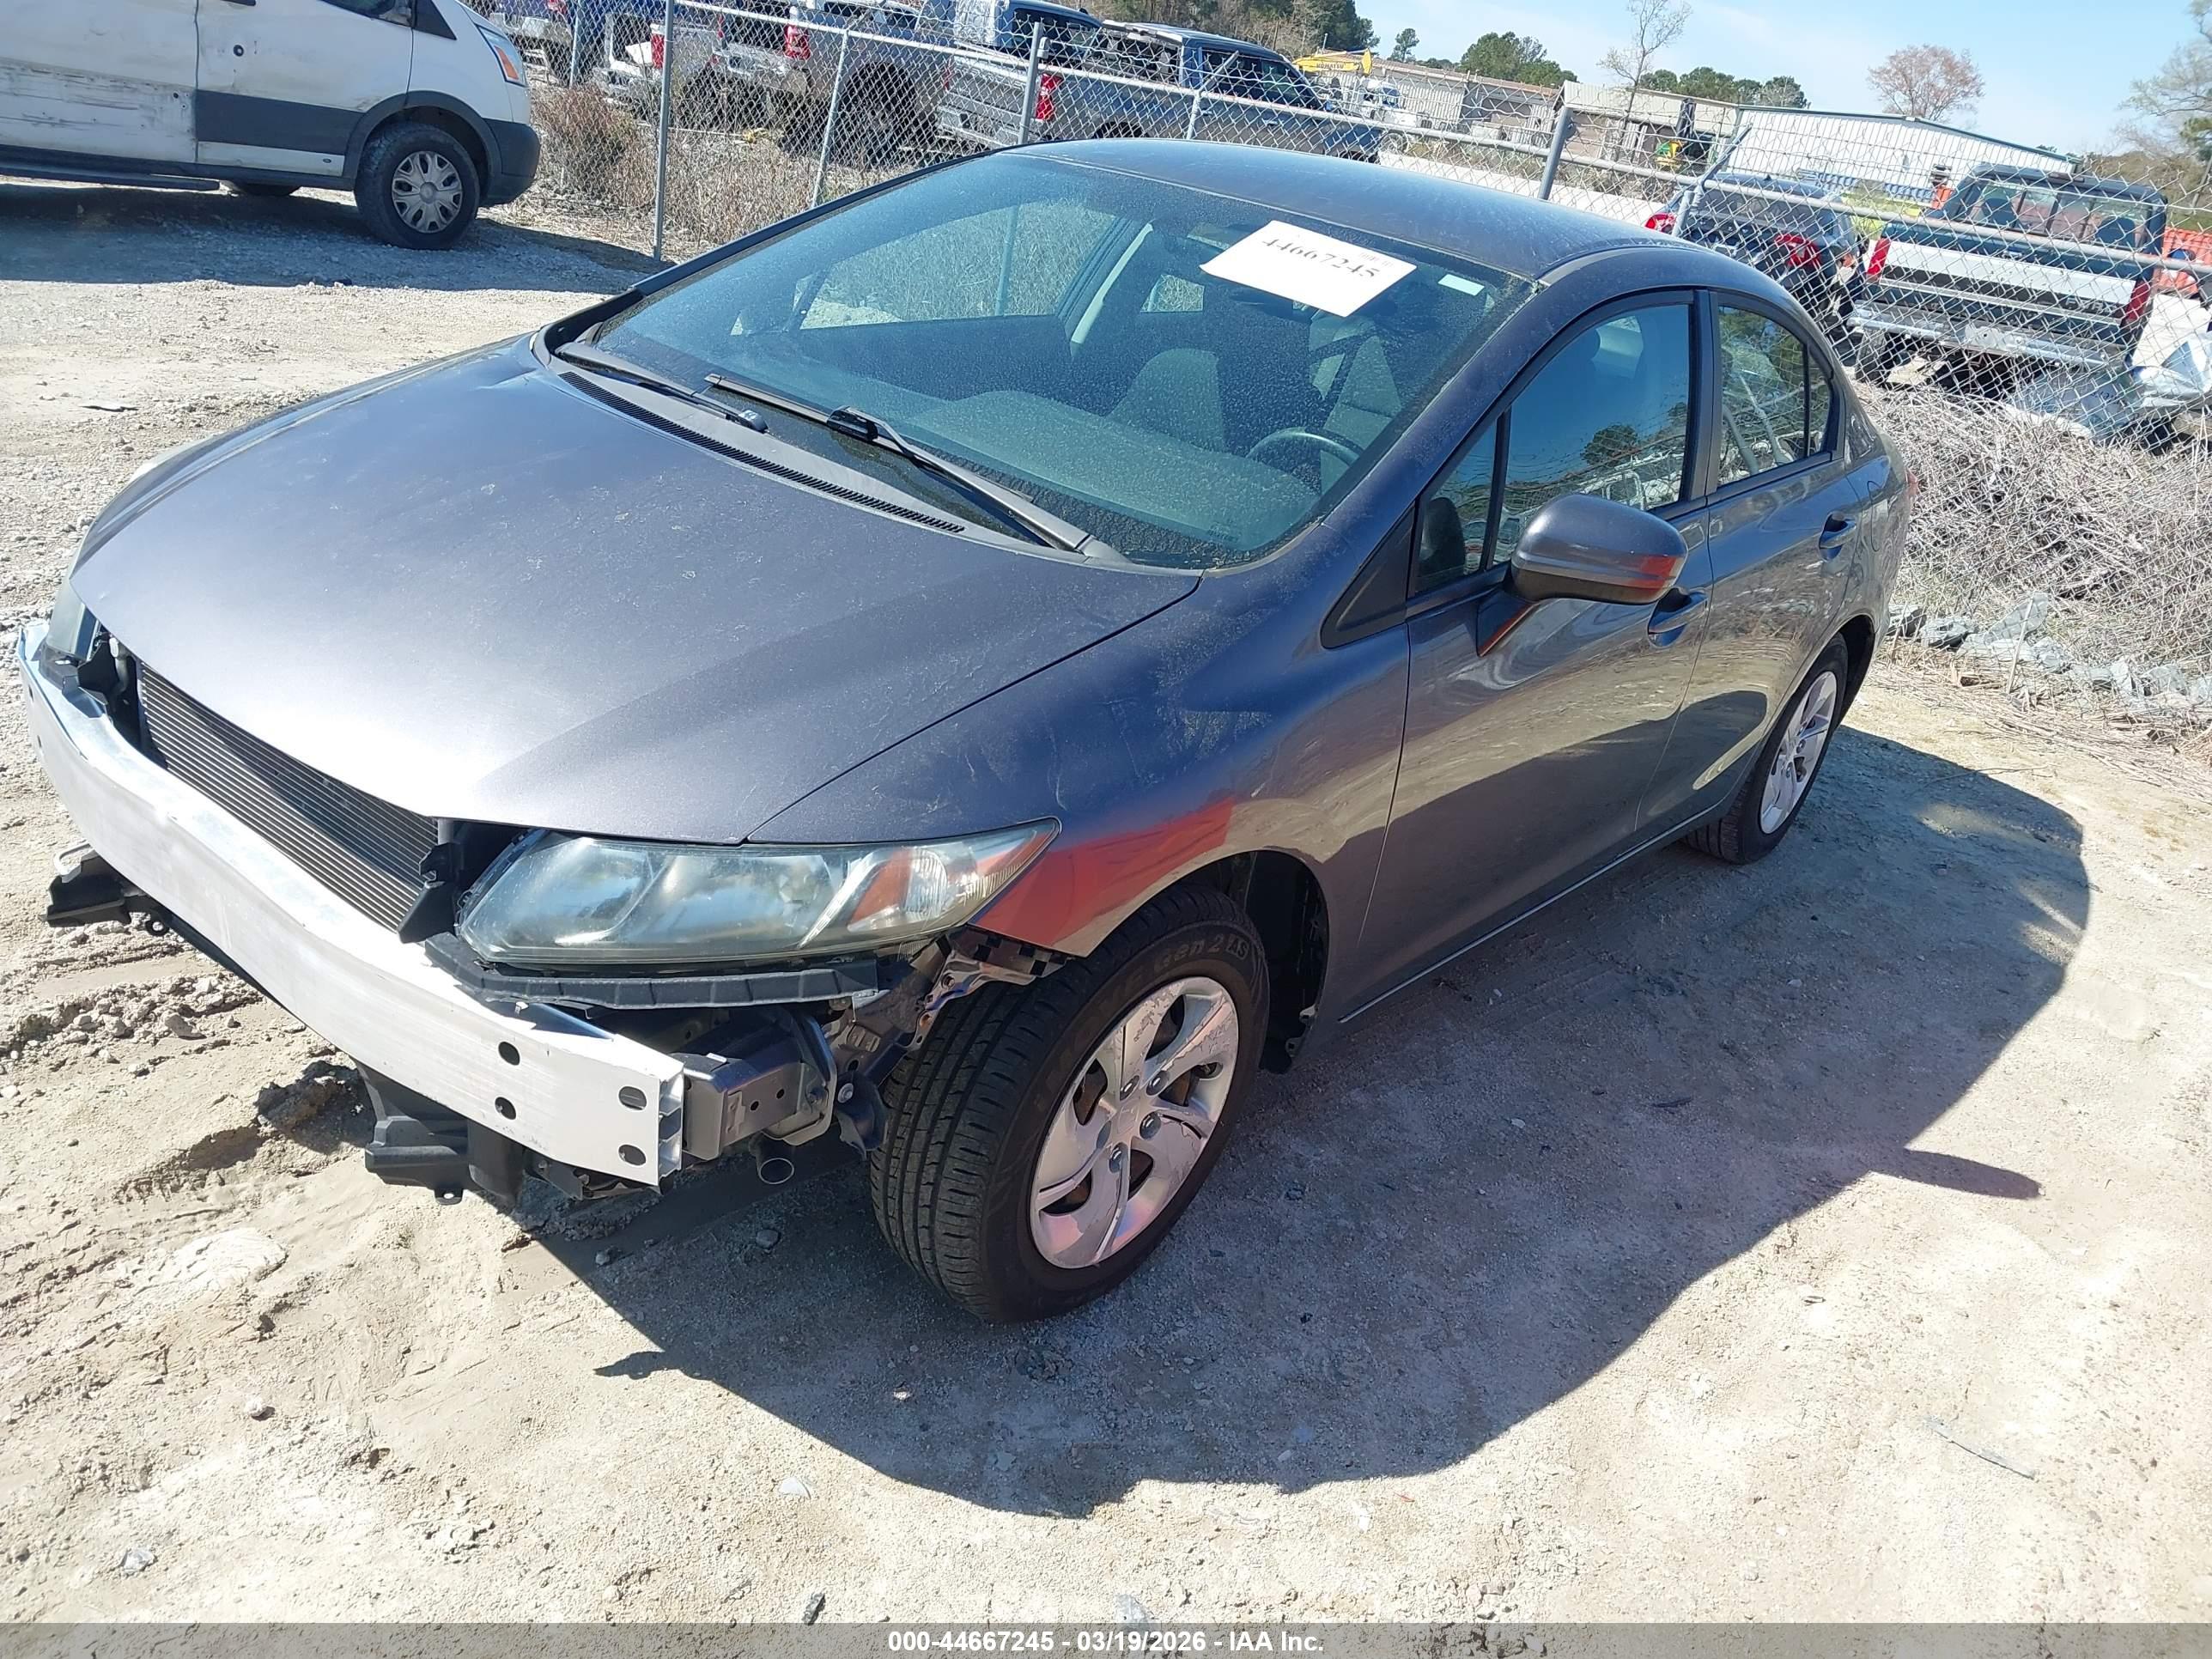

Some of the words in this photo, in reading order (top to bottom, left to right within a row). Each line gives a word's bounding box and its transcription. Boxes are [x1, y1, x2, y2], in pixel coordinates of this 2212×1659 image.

[1261, 239, 1381, 277] 44667245
[1208, 934, 1222, 953] 2
[1228, 939, 1250, 959] AS
